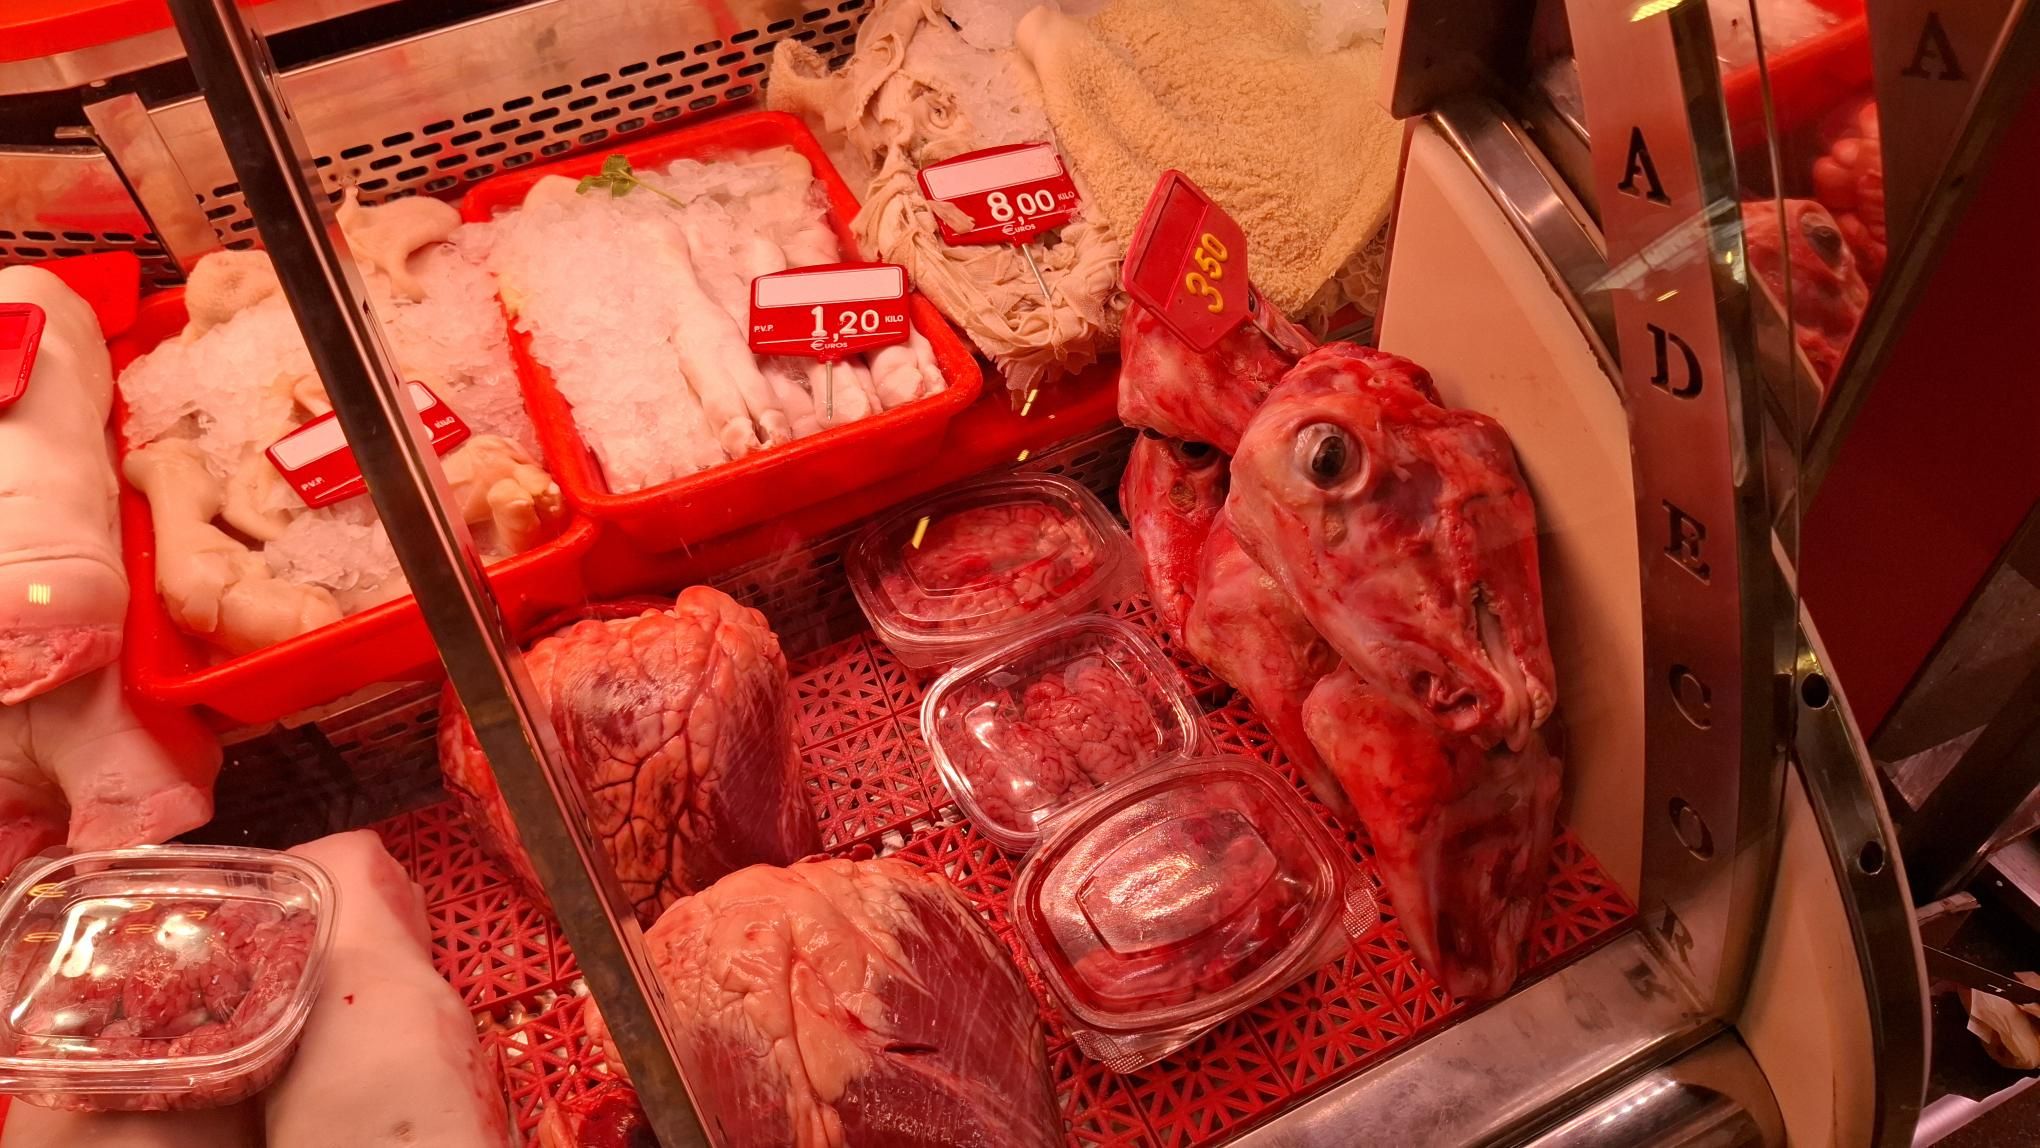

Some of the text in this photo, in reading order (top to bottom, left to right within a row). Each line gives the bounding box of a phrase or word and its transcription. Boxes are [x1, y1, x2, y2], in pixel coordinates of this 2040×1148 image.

[1902, 12, 1967, 81] A
[987, 189, 1075, 225] 8,00 KILO
[811, 305, 880, 342] 1,20
[884, 314, 904, 323] KILO
